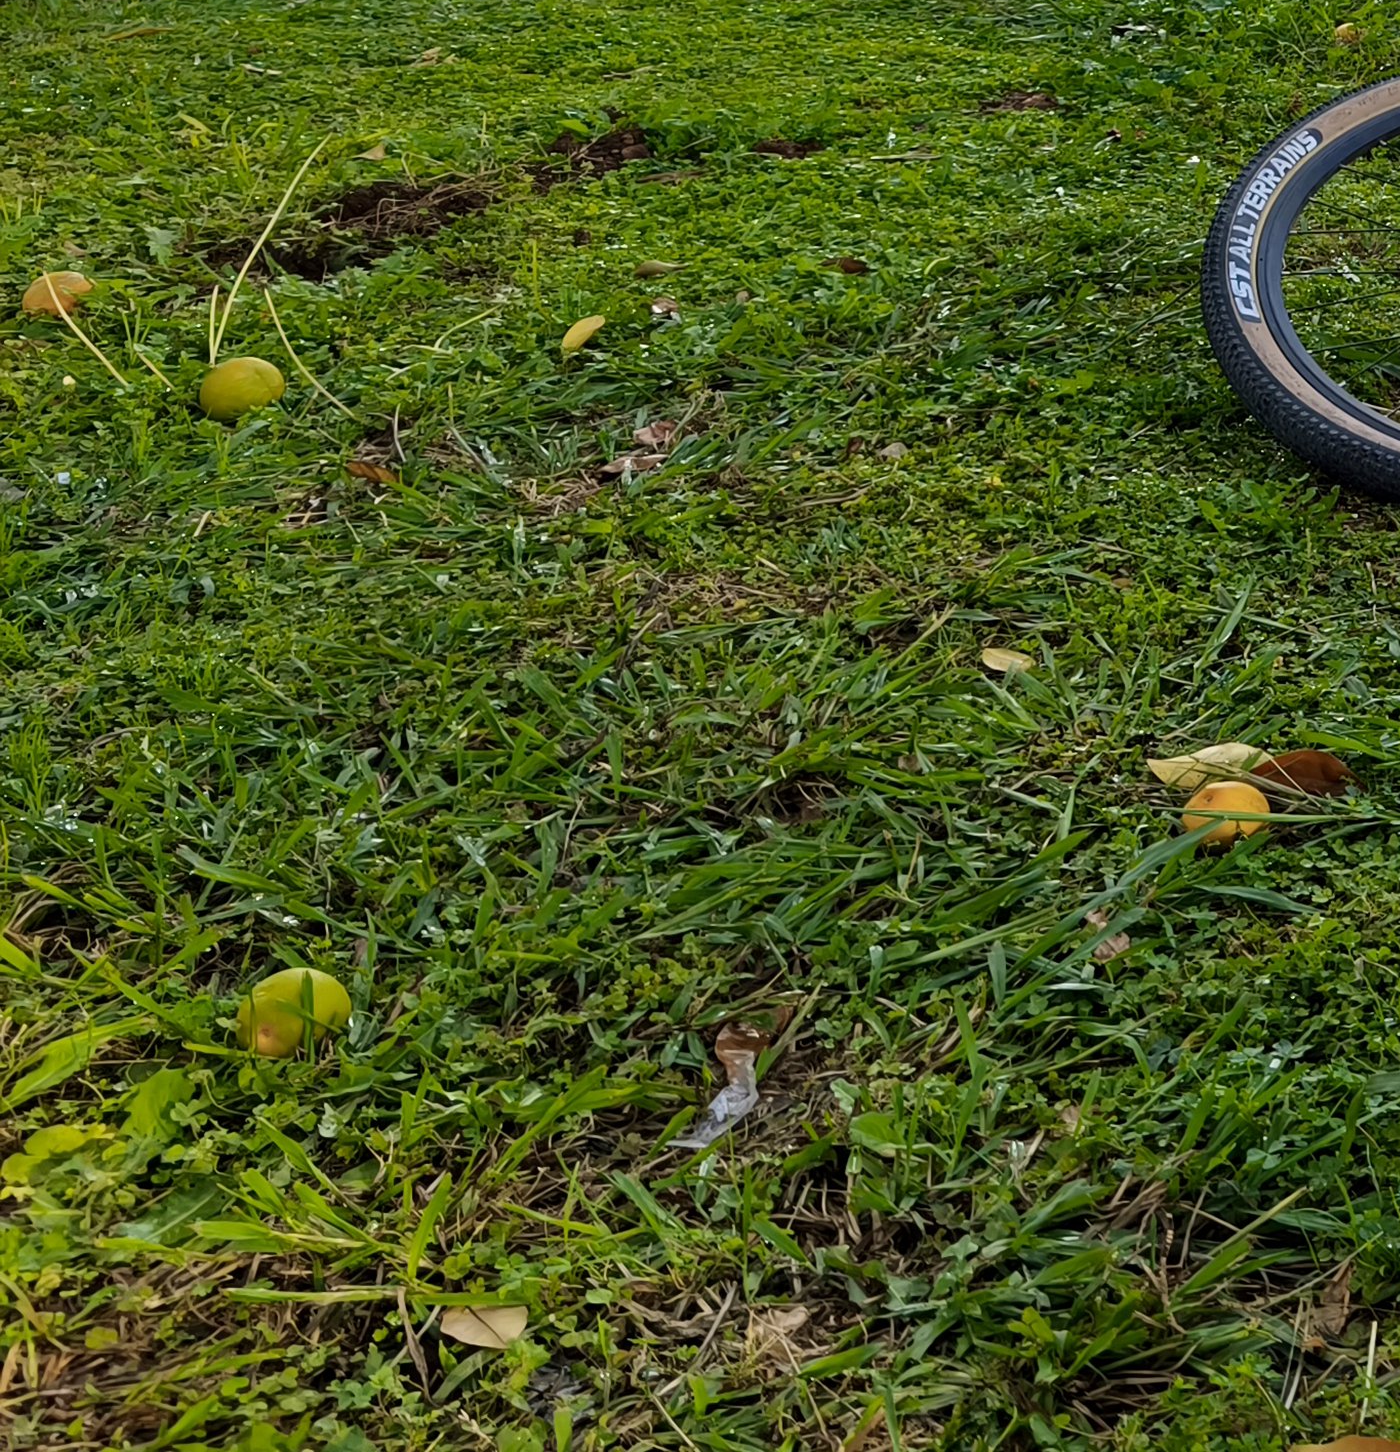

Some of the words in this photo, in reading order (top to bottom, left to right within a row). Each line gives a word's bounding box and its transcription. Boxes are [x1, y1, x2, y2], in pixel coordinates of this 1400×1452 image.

[1237, 130, 1318, 221] TERRAINS
[1229, 223, 1256, 264] ALL
[1228, 261, 1261, 320] CST
